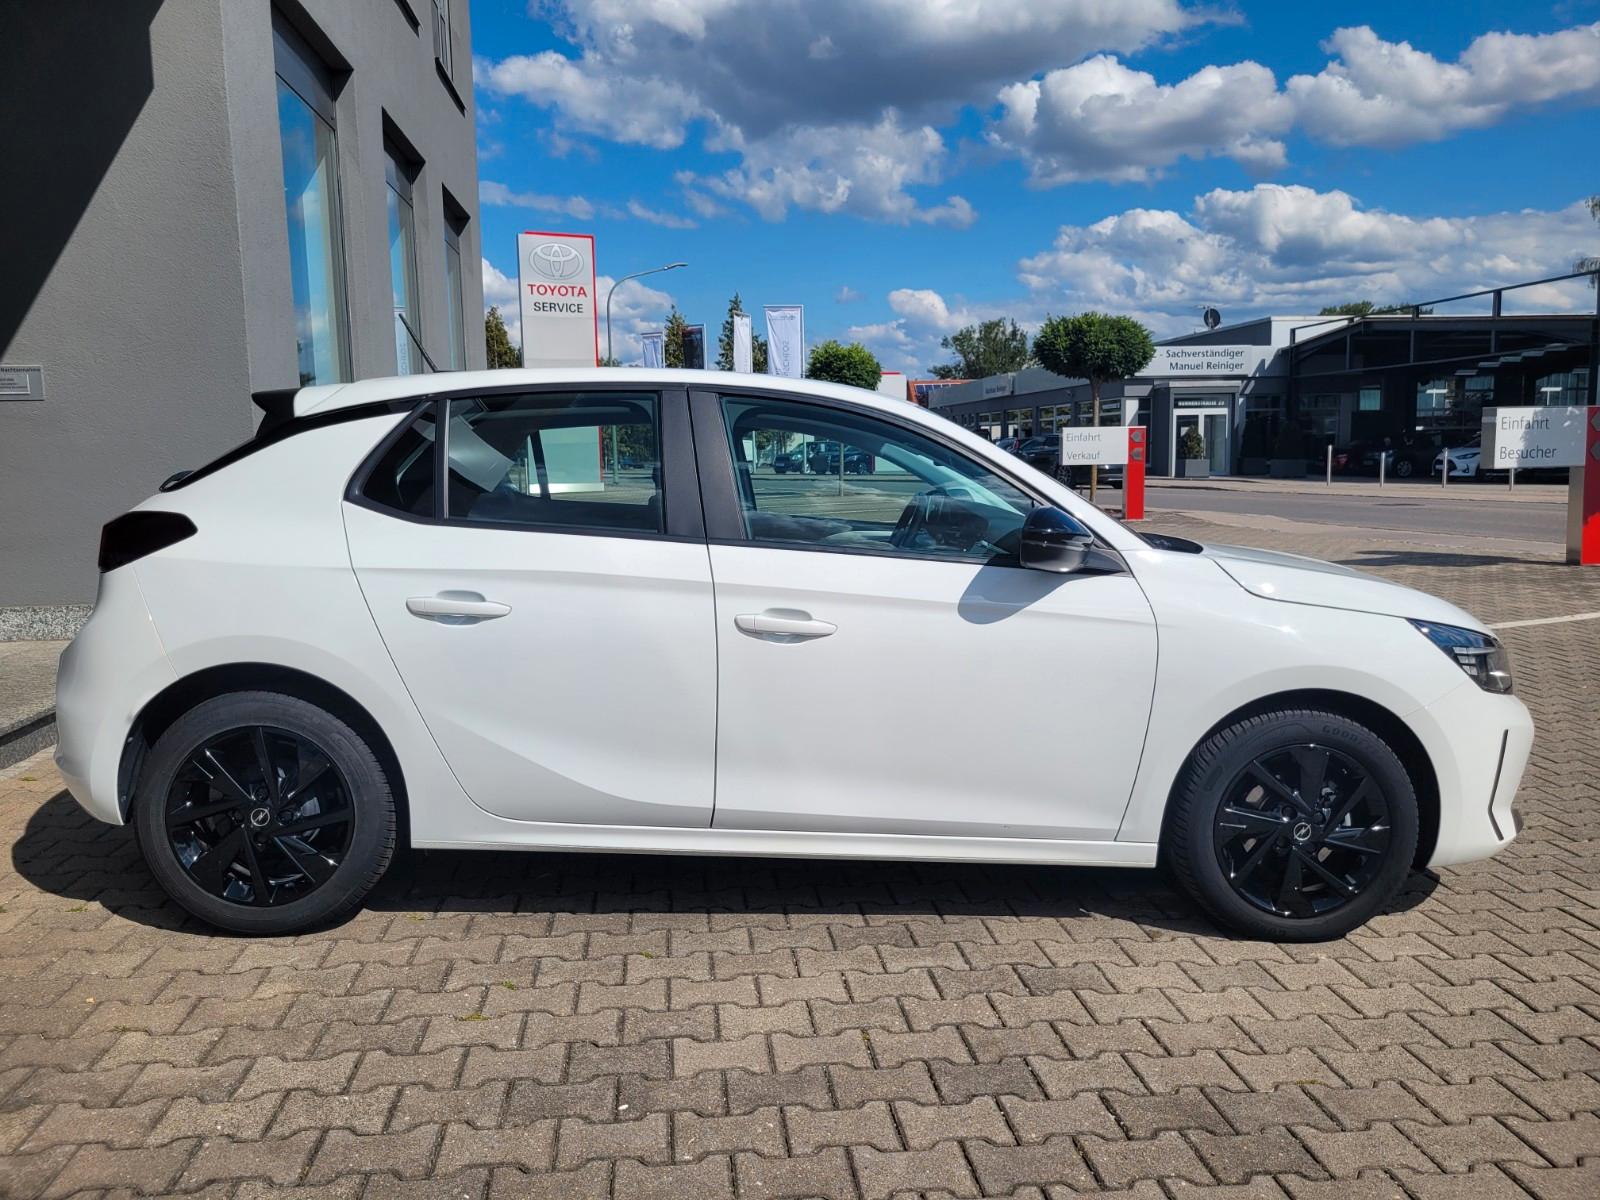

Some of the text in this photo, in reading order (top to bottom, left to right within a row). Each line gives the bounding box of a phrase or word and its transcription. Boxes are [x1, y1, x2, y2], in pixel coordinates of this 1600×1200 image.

[527, 284, 587, 297] TOYOTA
[533, 301, 583, 313] SERVICE
[1166, 349, 1244, 358] Sachverständiger
[1169, 361, 1244, 372] Manuel Reiniger
[1501, 416, 1550, 430] Einfahrt
[1066, 432, 1101, 442] Einfahrt
[1066, 451, 1100, 460] Verkauf
[1499, 444, 1557, 460] Besucher
